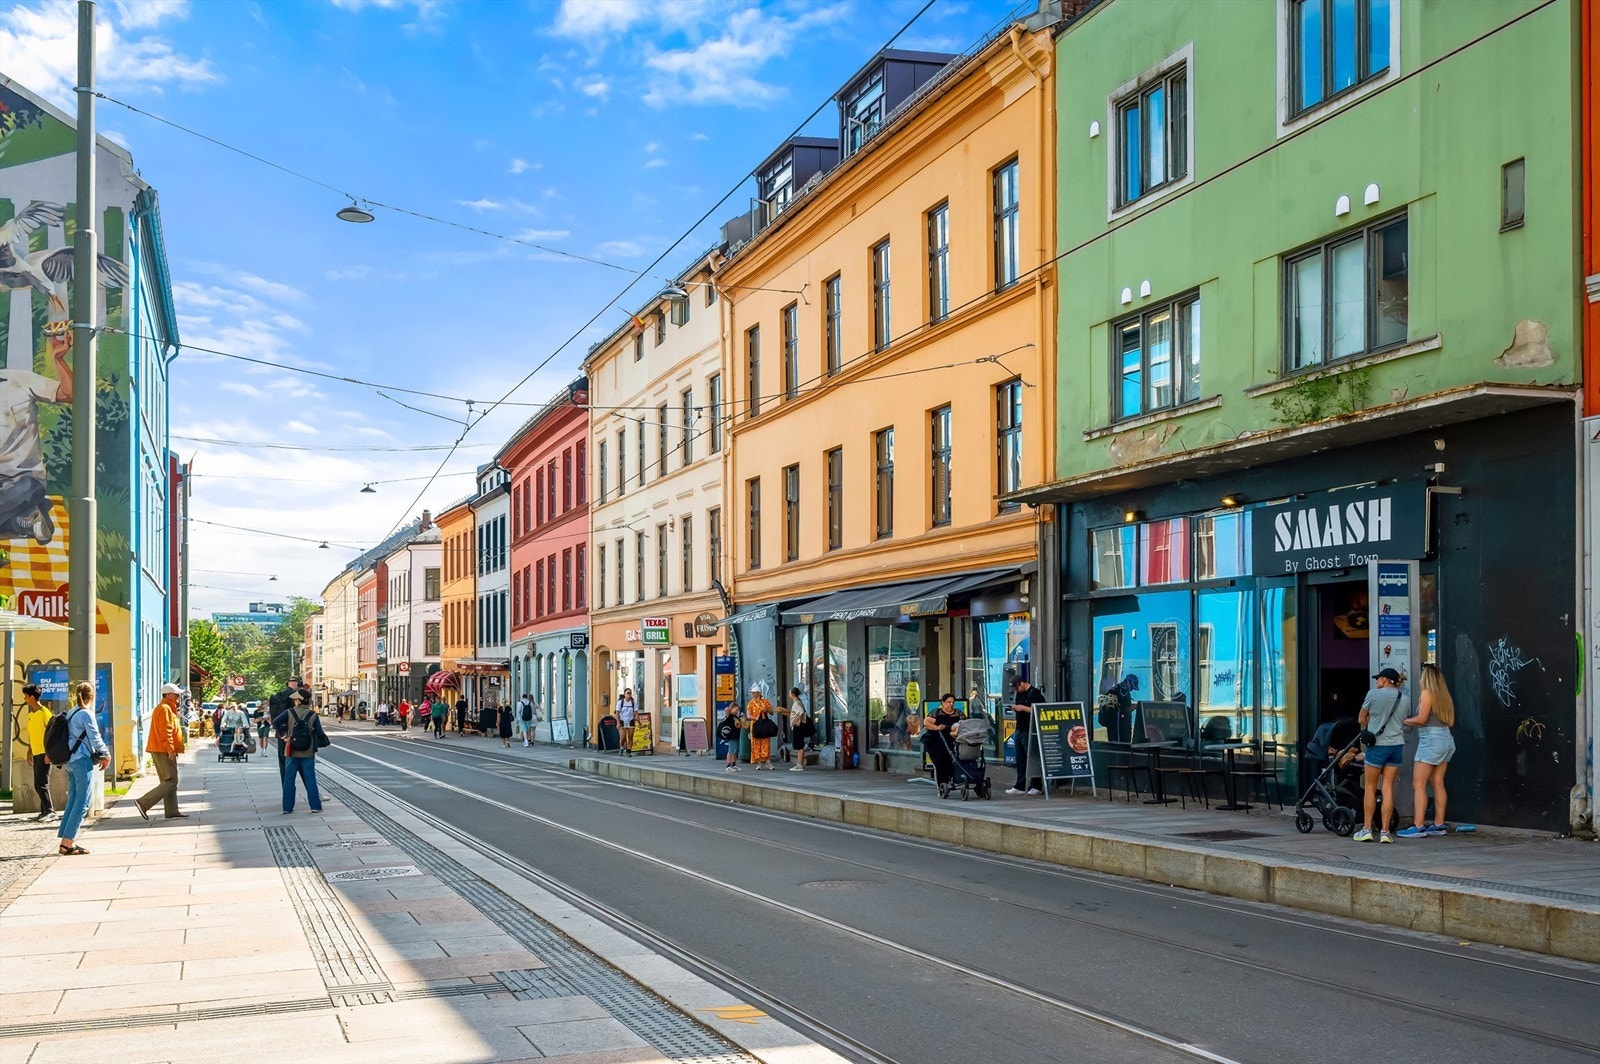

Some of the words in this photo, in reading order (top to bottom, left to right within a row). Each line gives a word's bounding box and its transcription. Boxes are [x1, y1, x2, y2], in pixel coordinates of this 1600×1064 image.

[1274, 497, 1392, 552] SMASH
[1285, 559, 1299, 573] By
[1305, 556, 1341, 570] Ghost
[645, 619, 667, 627] TEXAS
[1013, 615, 1027, 626] ATM
[646, 631, 667, 640] GRILL
[1039, 708, 1081, 721] ÅPENT!
